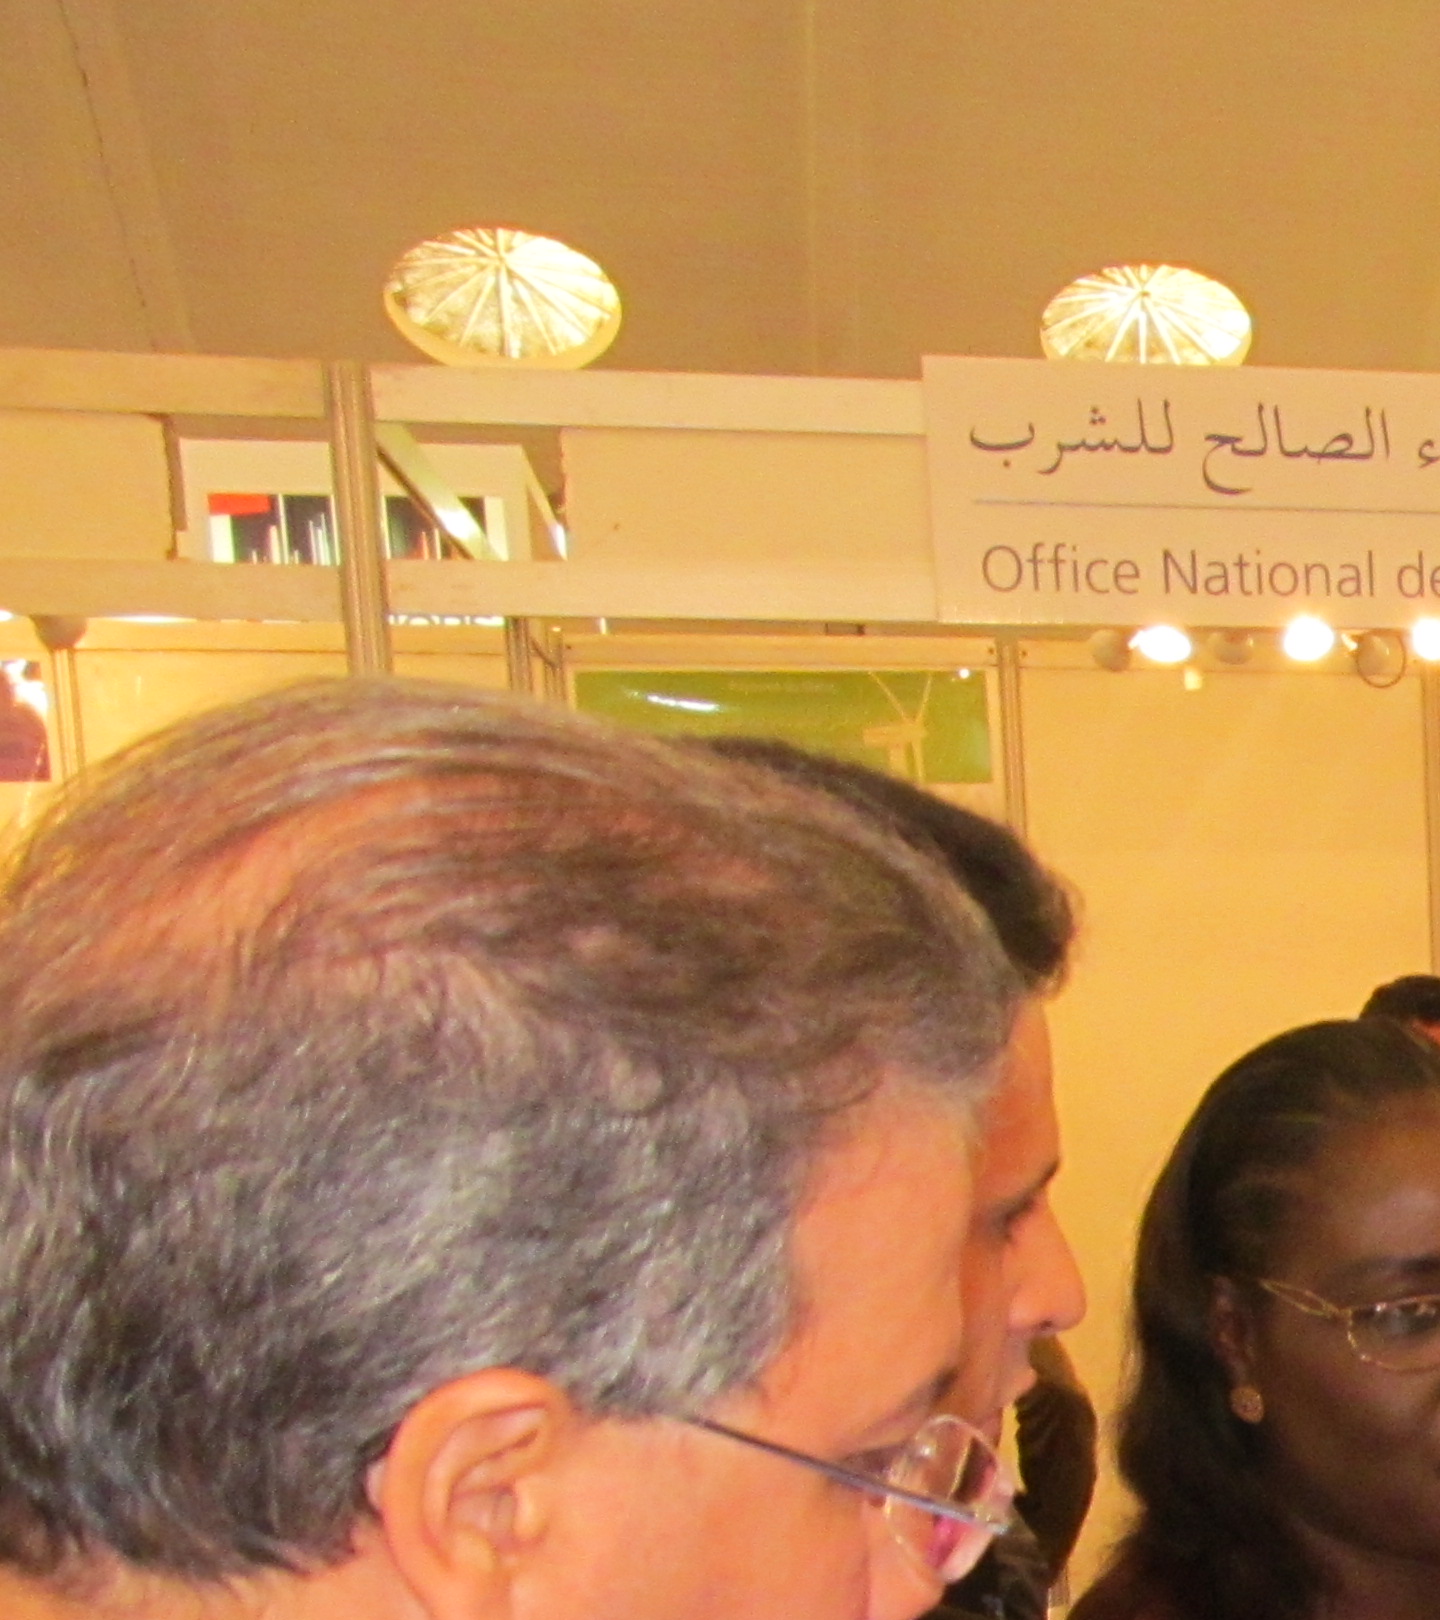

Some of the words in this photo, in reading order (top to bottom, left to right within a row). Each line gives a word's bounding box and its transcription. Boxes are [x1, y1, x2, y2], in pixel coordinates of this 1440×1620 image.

[969, 398, 1174, 475] للشرب
[1202, 402, 1391, 496] الصالح
[981, 541, 1141, 595] Office
[1162, 549, 1375, 598] National
